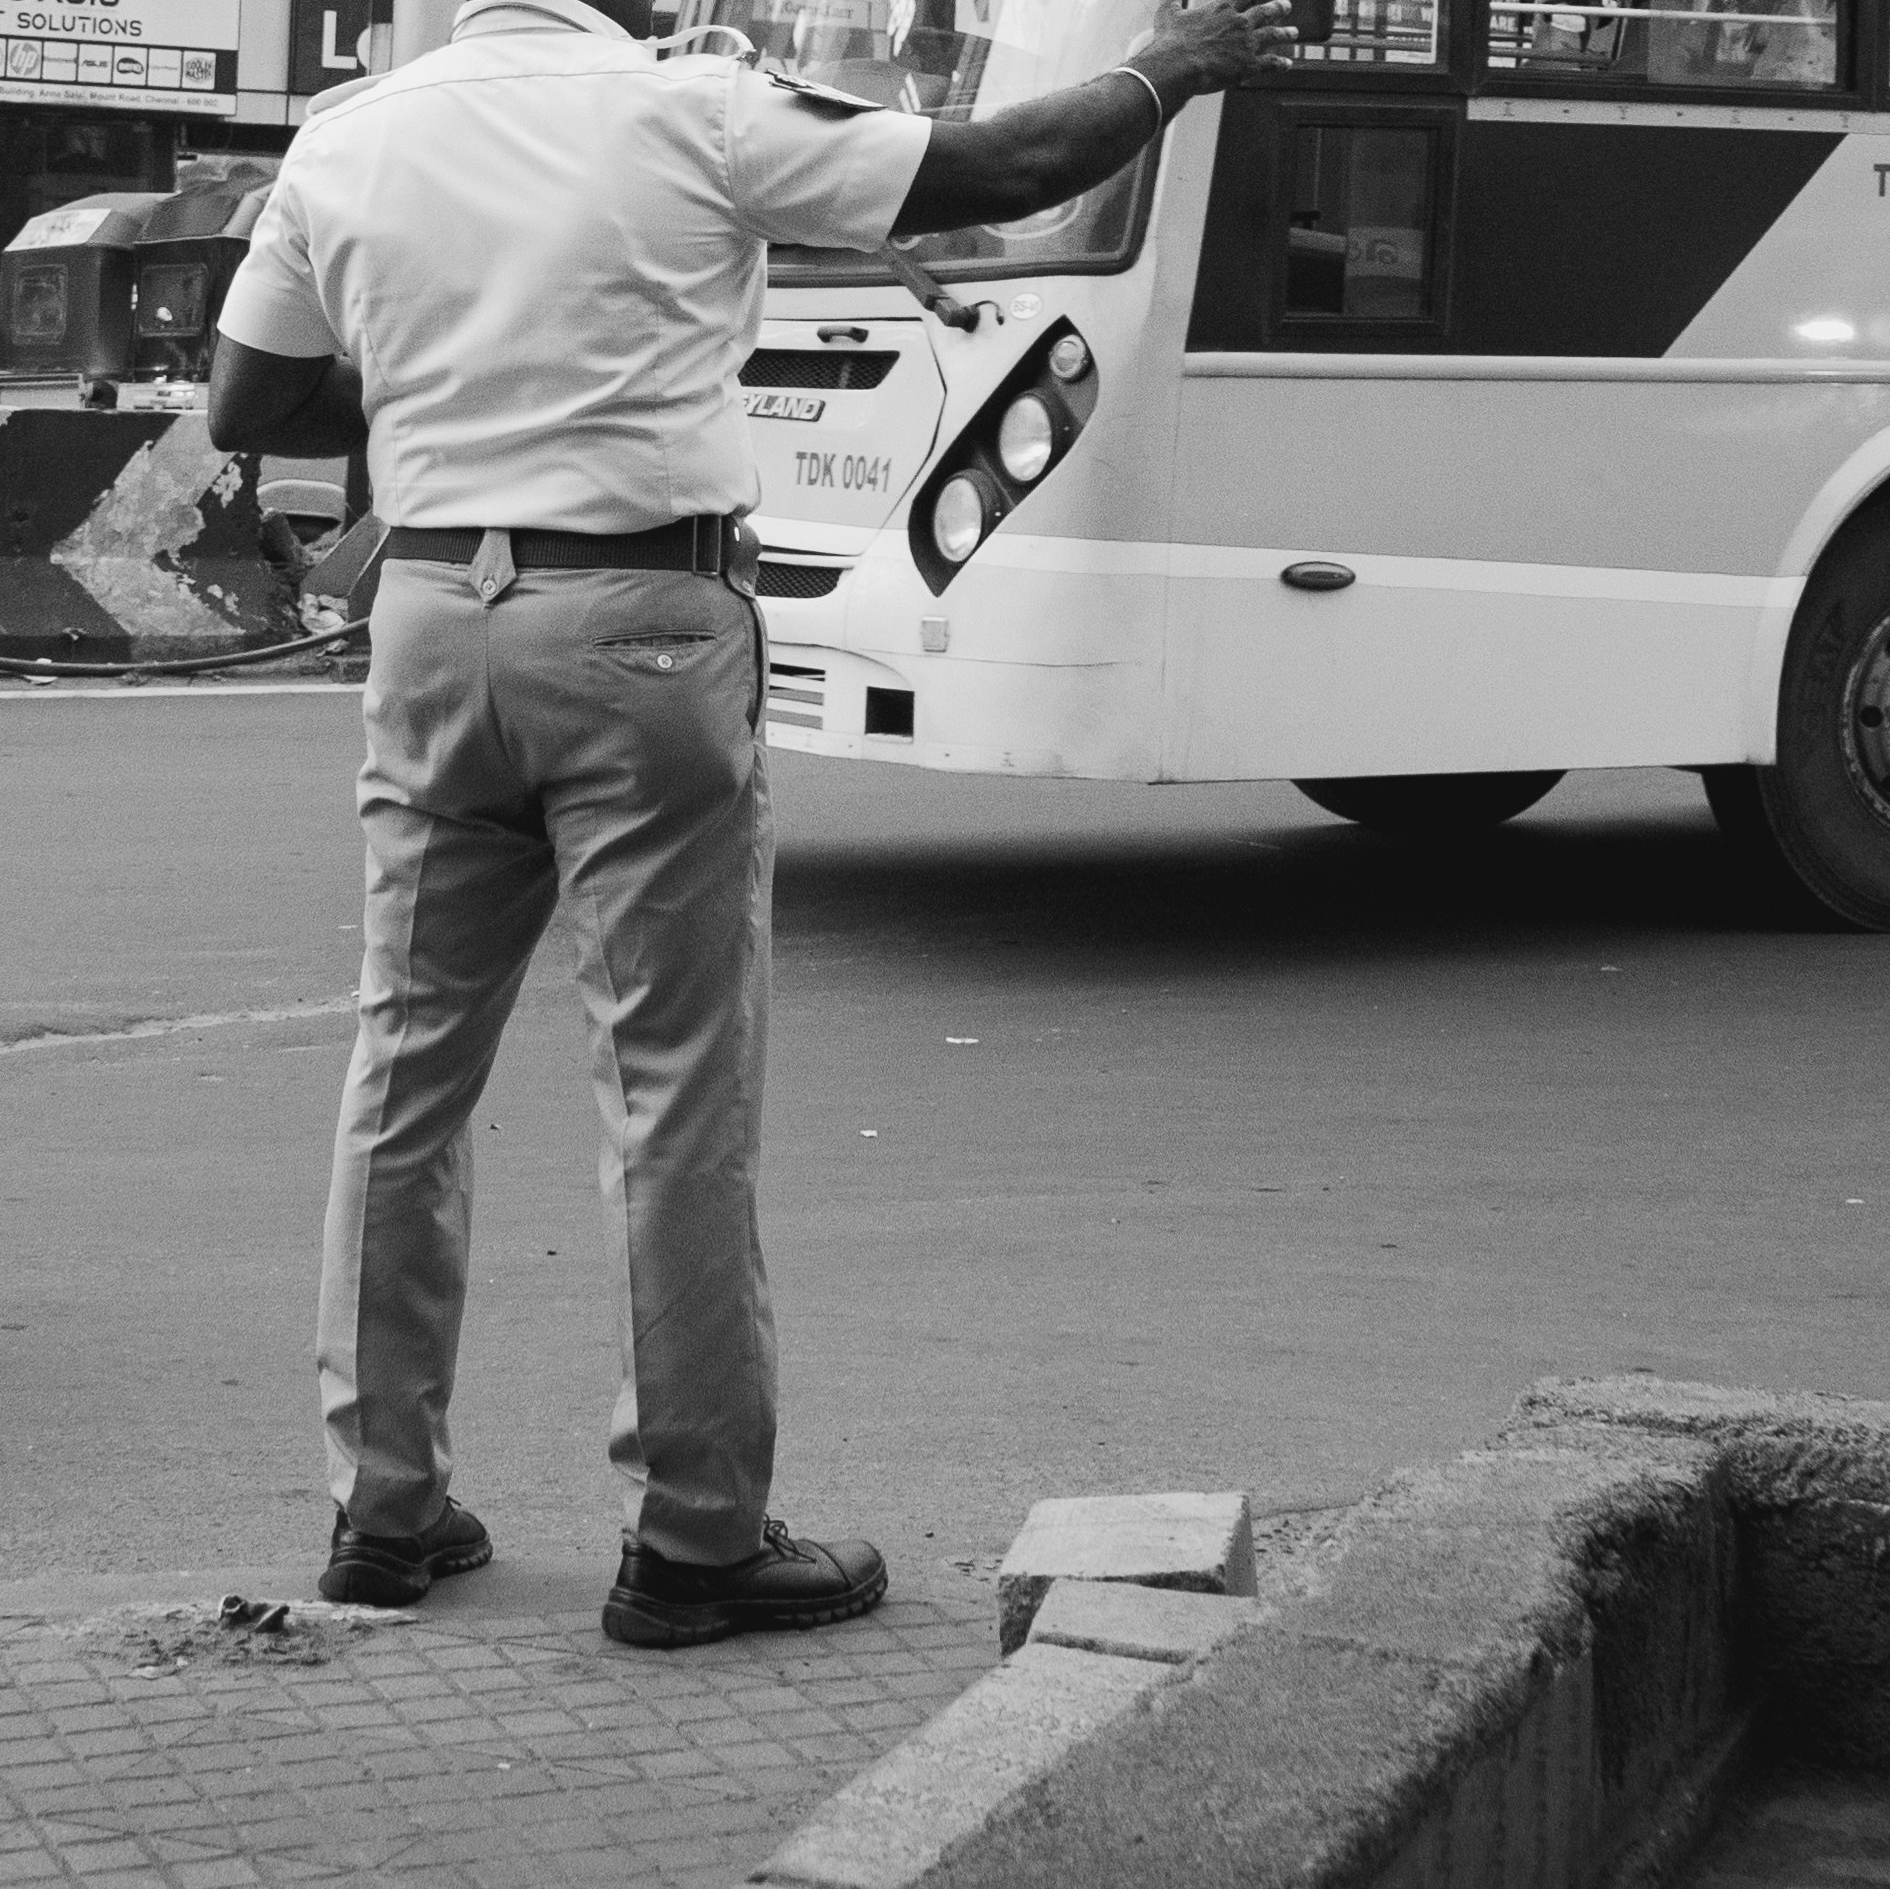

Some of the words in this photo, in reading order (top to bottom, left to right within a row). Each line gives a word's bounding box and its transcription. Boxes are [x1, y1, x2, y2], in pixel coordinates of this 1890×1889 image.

[16, 11, 144, 38] SOLUTIONS
[795, 451, 836, 488] TDK
[841, 453, 893, 494] 0041
